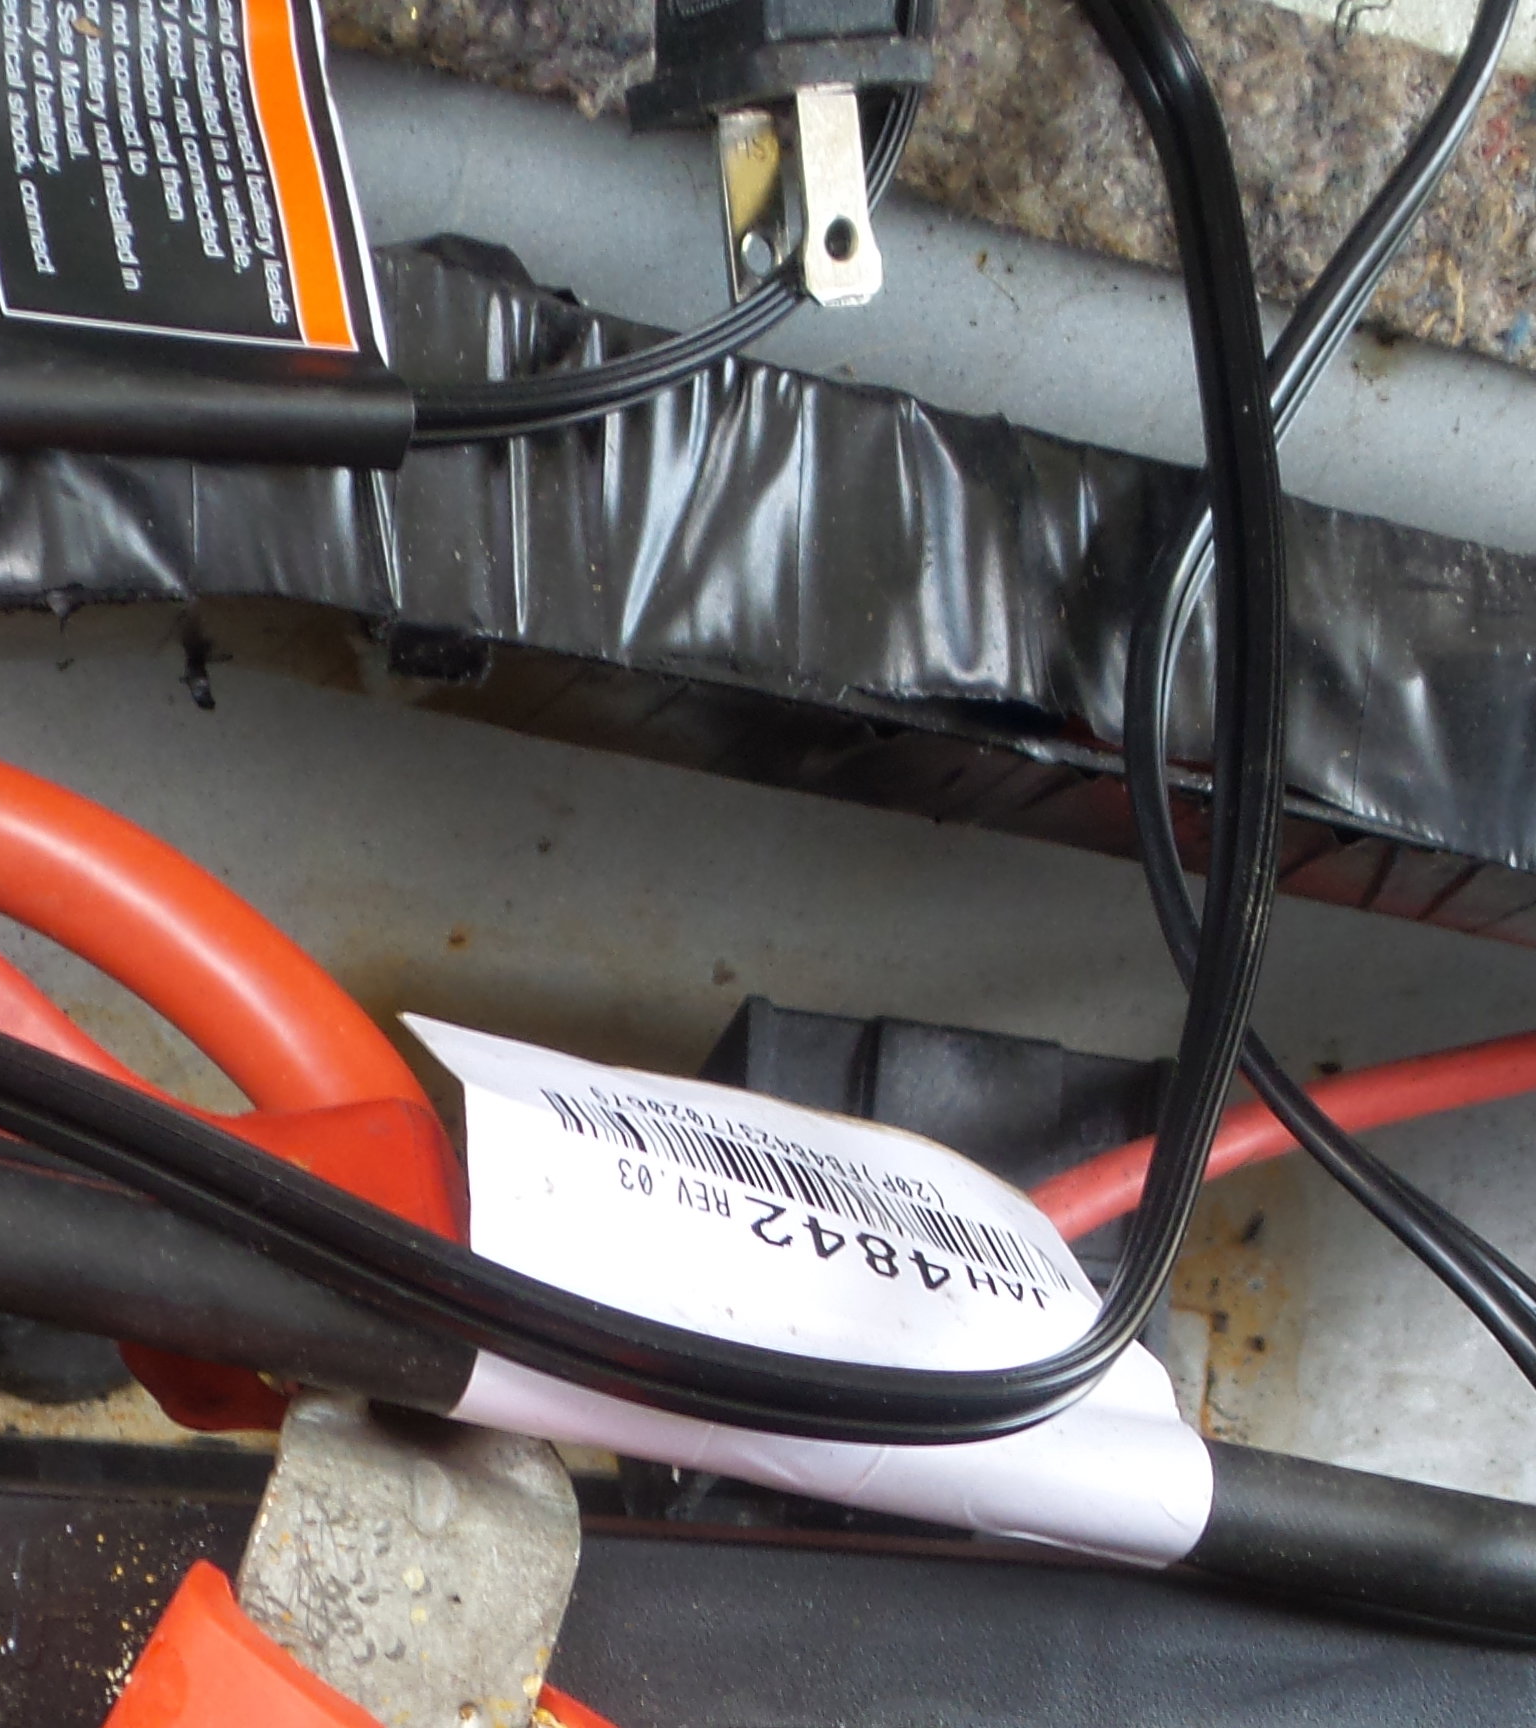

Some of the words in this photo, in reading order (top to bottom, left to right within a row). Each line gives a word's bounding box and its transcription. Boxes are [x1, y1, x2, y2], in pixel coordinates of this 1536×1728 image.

[111, 2, 130, 46] not
[218, 0, 238, 46] and
[32, 50, 54, 82] of
[194, 38, 226, 137] installed
[113, 50, 145, 148] connect
[222, 50, 262, 170] disconnect
[93, 122, 120, 161] not
[128, 150, 148, 175] to
[149, 120, 178, 165] and
[210, 139, 229, 160] in
[160, 167, 184, 221] then
[182, 137, 225, 258] connected
[216, 164, 233, 181] a
[19, 179, 56, 274] connect
[102, 164, 140, 265] installed
[246, 175, 275, 255] battery
[120, 267, 142, 291] in
[263, 259, 290, 324] leads
